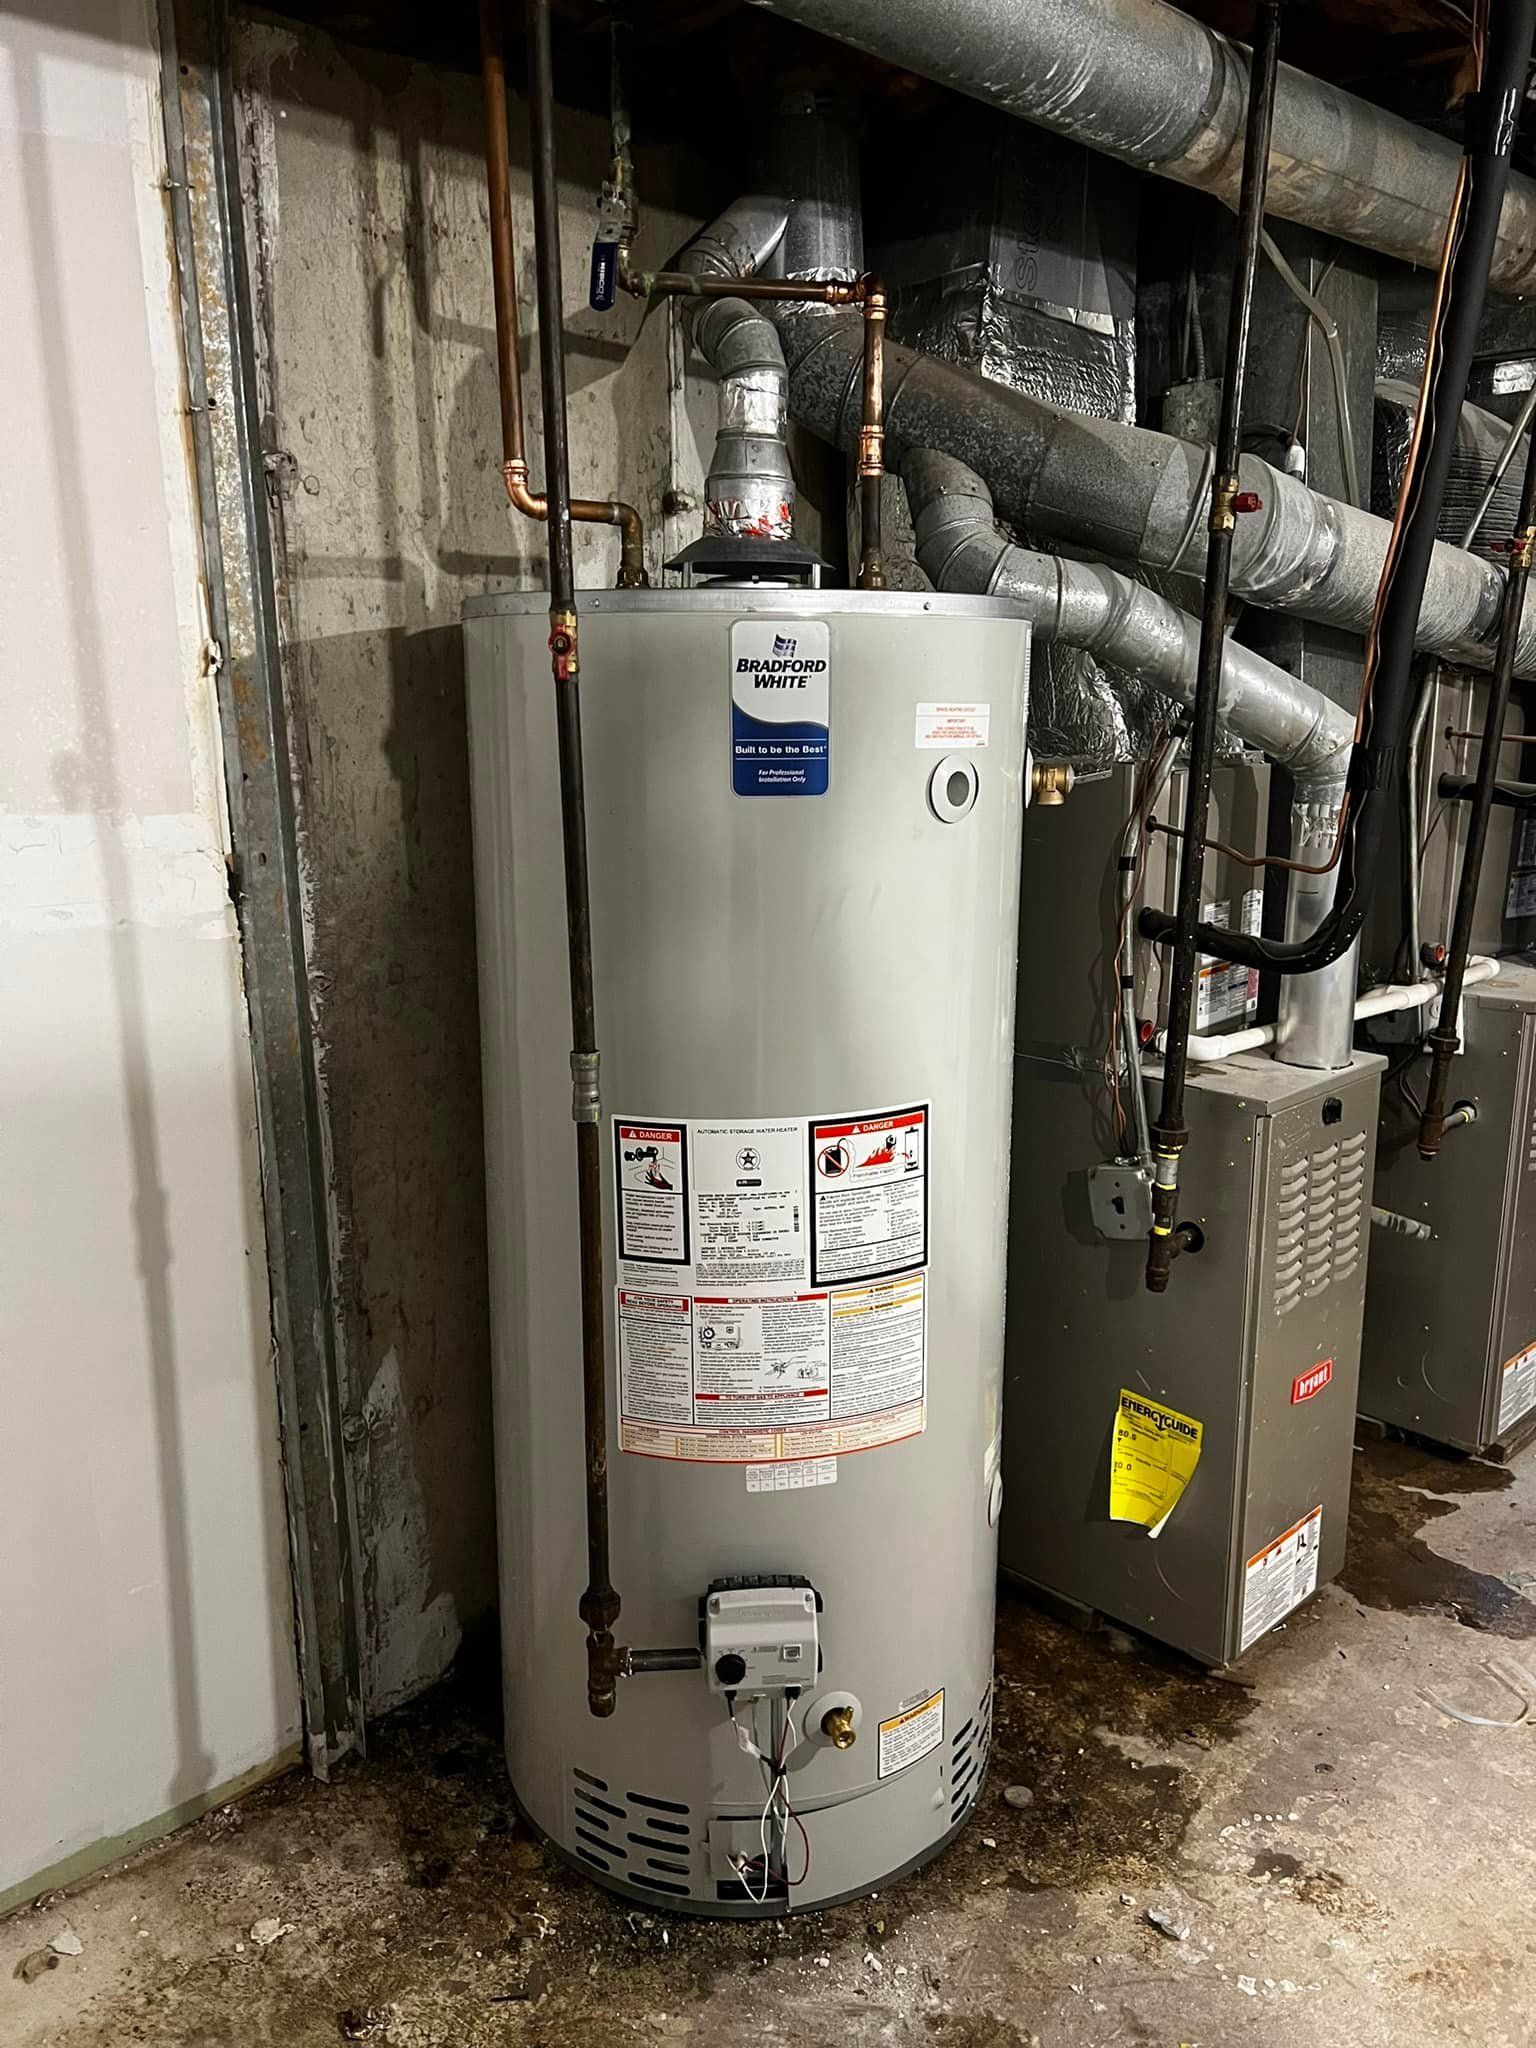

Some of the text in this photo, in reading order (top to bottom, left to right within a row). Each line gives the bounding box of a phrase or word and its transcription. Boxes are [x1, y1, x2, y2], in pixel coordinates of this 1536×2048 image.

[736, 658, 827, 673] BRADFORD
[754, 674, 808, 689] WHITE
[735, 745, 756, 754] Built
[758, 745, 768, 754] to
[770, 745, 782, 754] be
[785, 745, 800, 753] the
[792, 776, 807, 784] Only
[863, 1120, 894, 1131] DANGER
[640, 1131, 673, 1140] DANGER
[1299, 1365, 1328, 1397] bryant
[1120, 1396, 1199, 1440] ENERGYGUIDE
